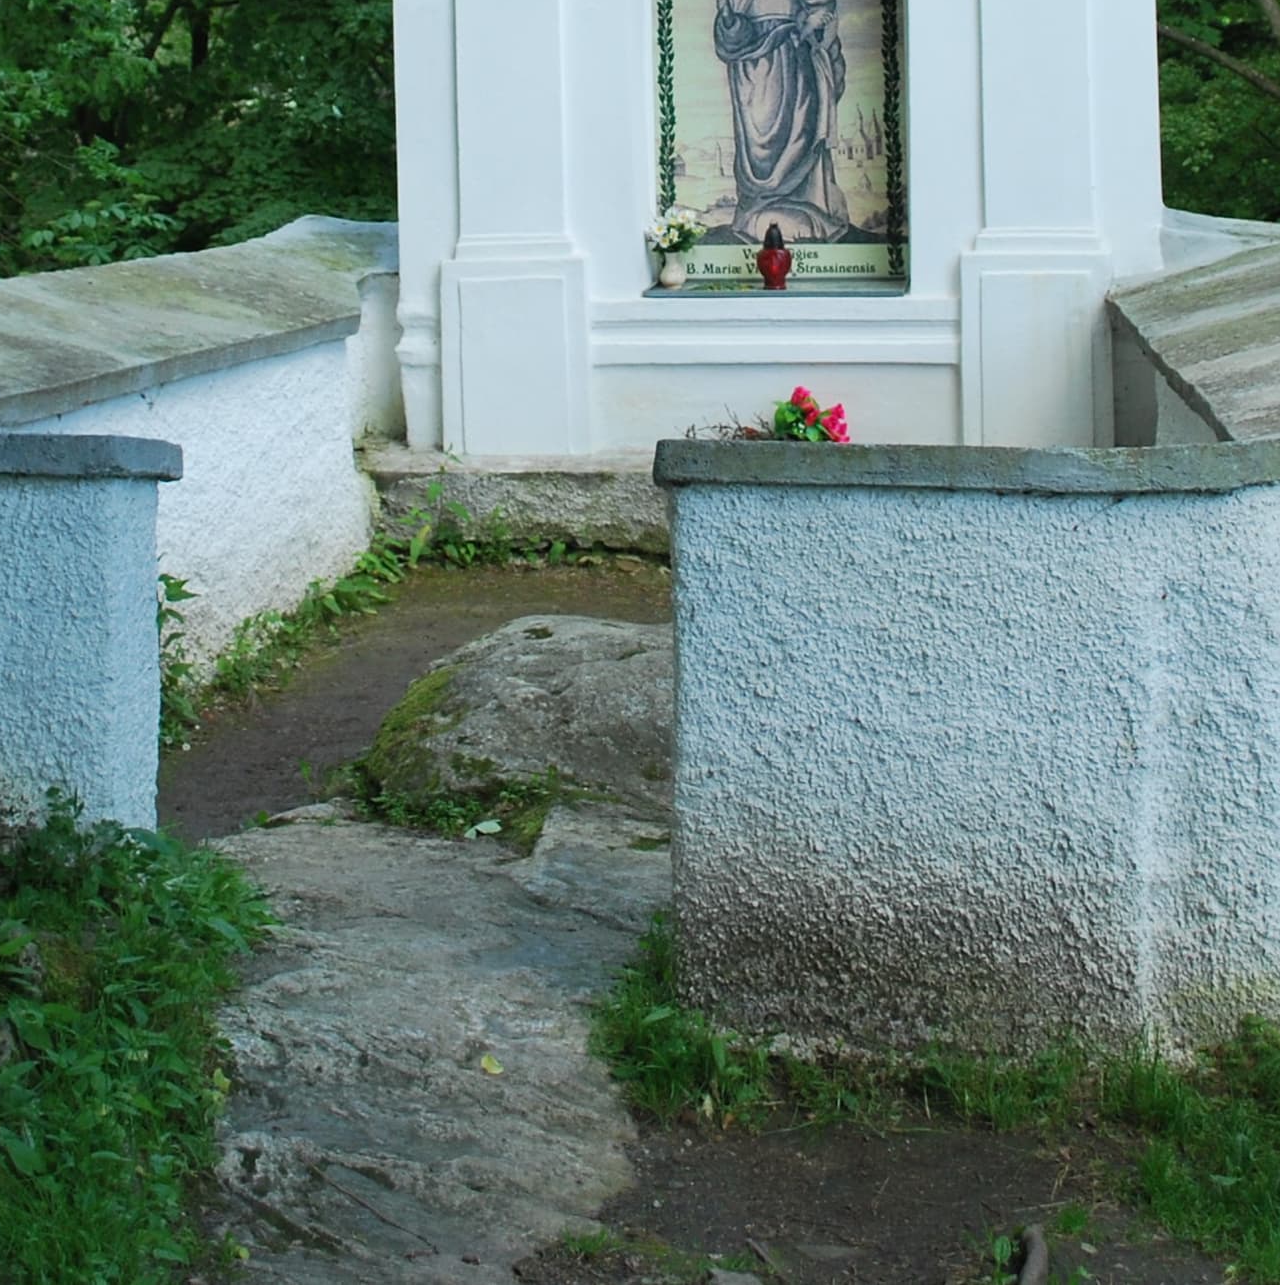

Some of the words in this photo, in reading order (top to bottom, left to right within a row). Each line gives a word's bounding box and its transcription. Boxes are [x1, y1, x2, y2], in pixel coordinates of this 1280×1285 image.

[743, 248, 758, 260] Ve
[786, 248, 819, 261] igies
[686, 262, 699, 275] B.
[702, 262, 743, 275] Mariæ
[796, 262, 876, 274] Strassinensis
